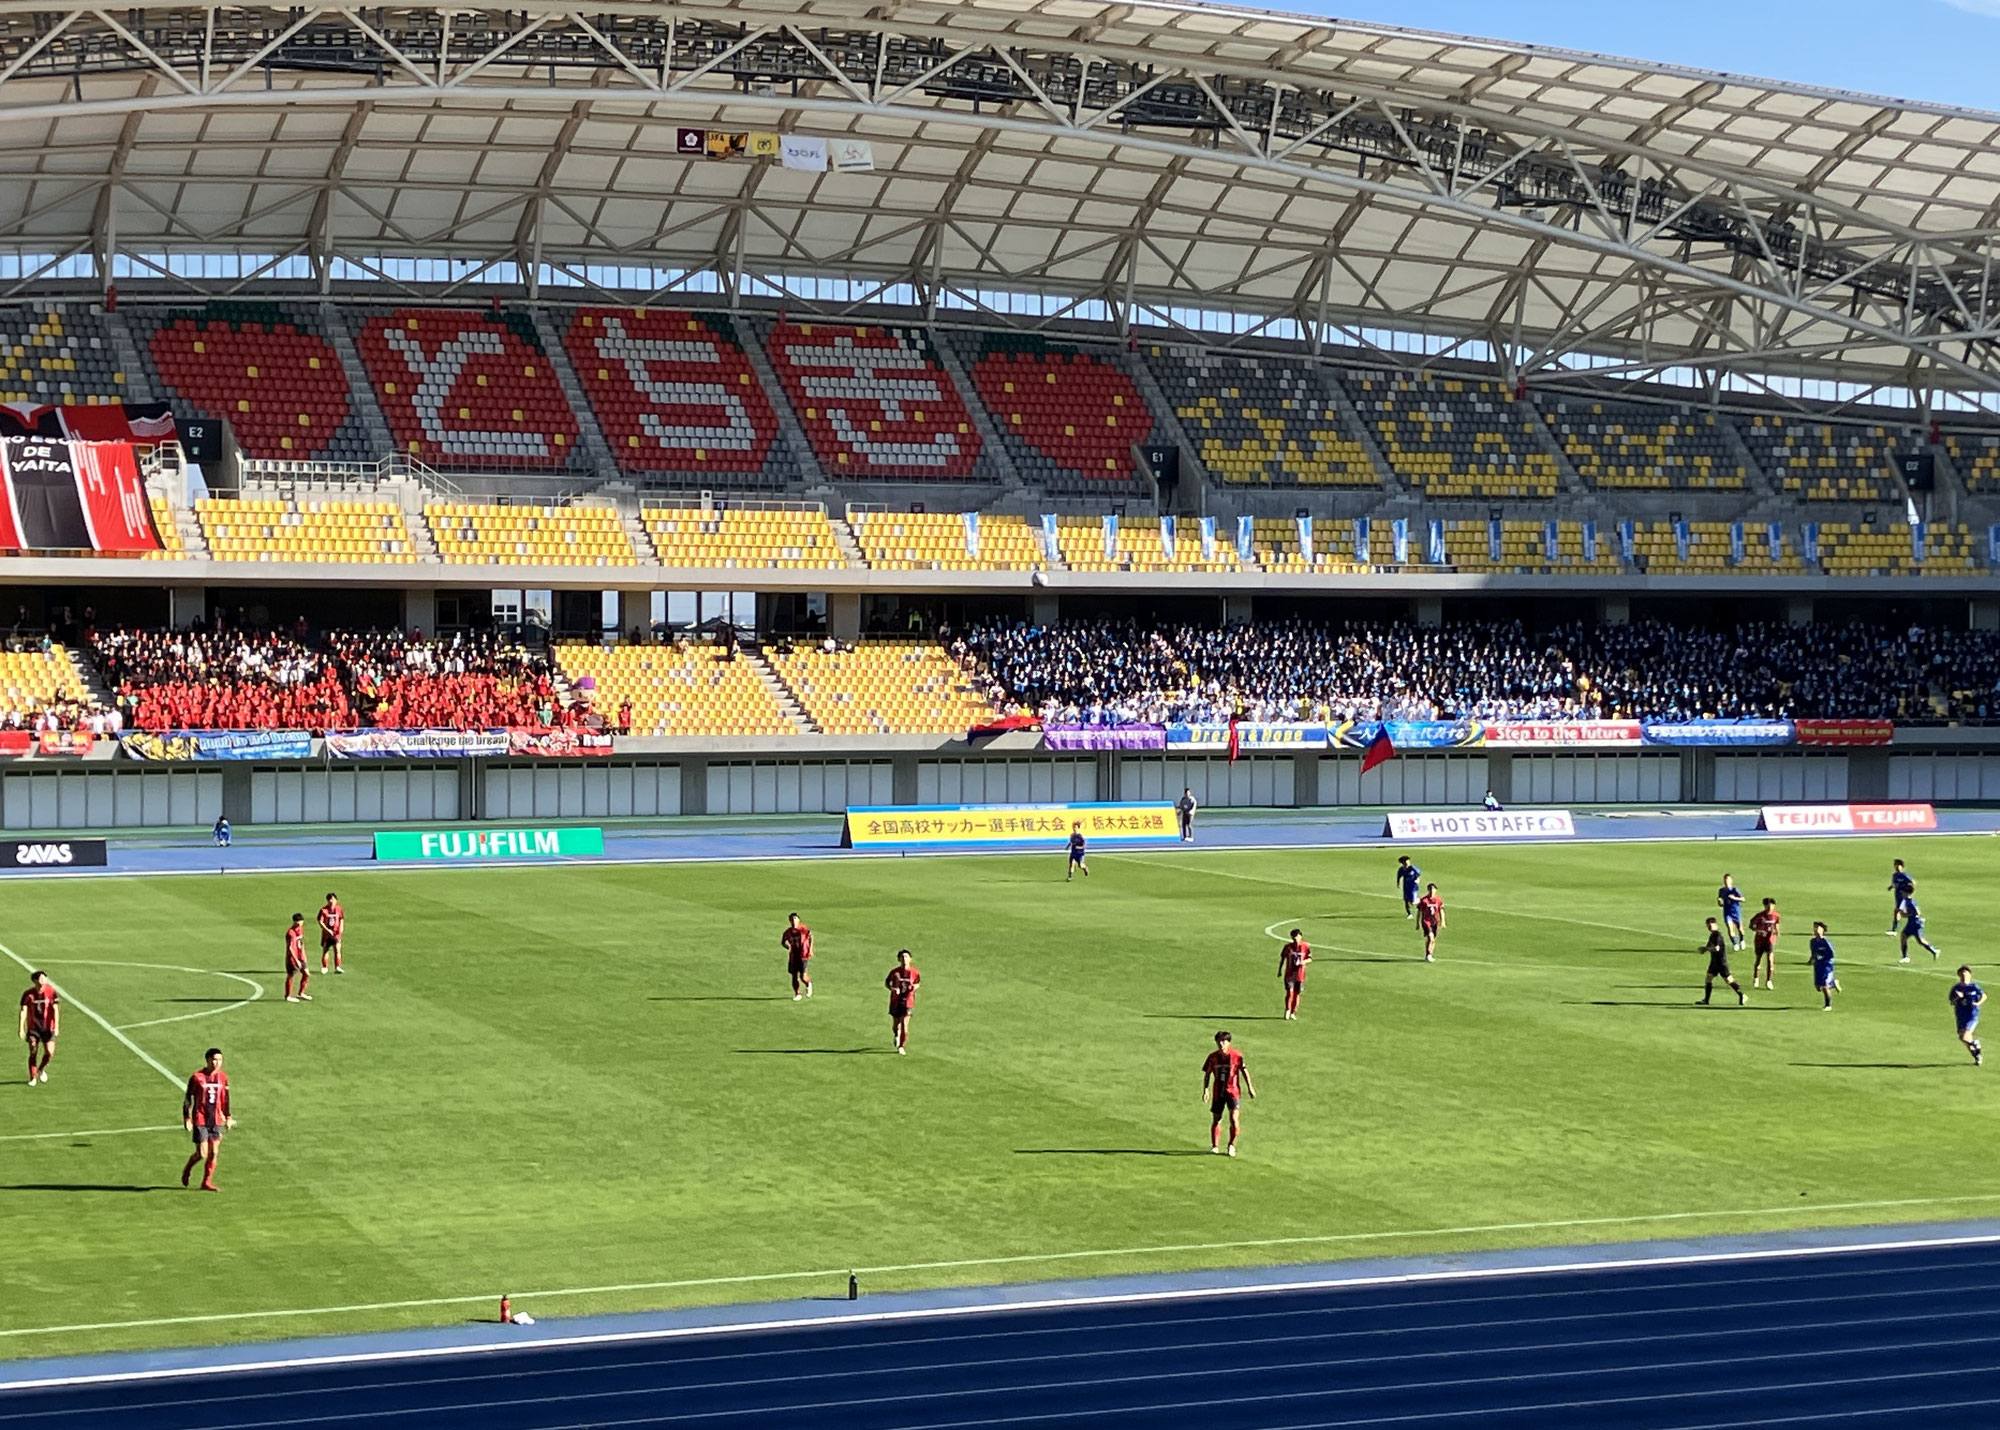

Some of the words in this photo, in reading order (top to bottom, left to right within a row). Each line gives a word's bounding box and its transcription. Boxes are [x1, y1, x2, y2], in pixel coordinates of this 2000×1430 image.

[188, 426, 204, 438] E2
[23, 446, 52, 458] DE
[1152, 452, 1164, 463] E1
[11, 459, 71, 473] YAITA
[1496, 728, 1531, 741] Step
[1533, 727, 1550, 740] to
[1553, 727, 1578, 740] the
[1580, 727, 1630, 740] future
[867, 817, 1066, 835] 全国高校サッカー選手権大会
[1092, 814, 1164, 831] 栃木大会決勝
[1431, 817, 1470, 833] HOT
[1476, 815, 1536, 832] STAFF
[1775, 812, 1841, 826] TEIJIN
[1856, 810, 1925, 825] TEIJIN
[421, 831, 560, 857] FUJIFILM
[16, 843, 73, 864] SAVAS
